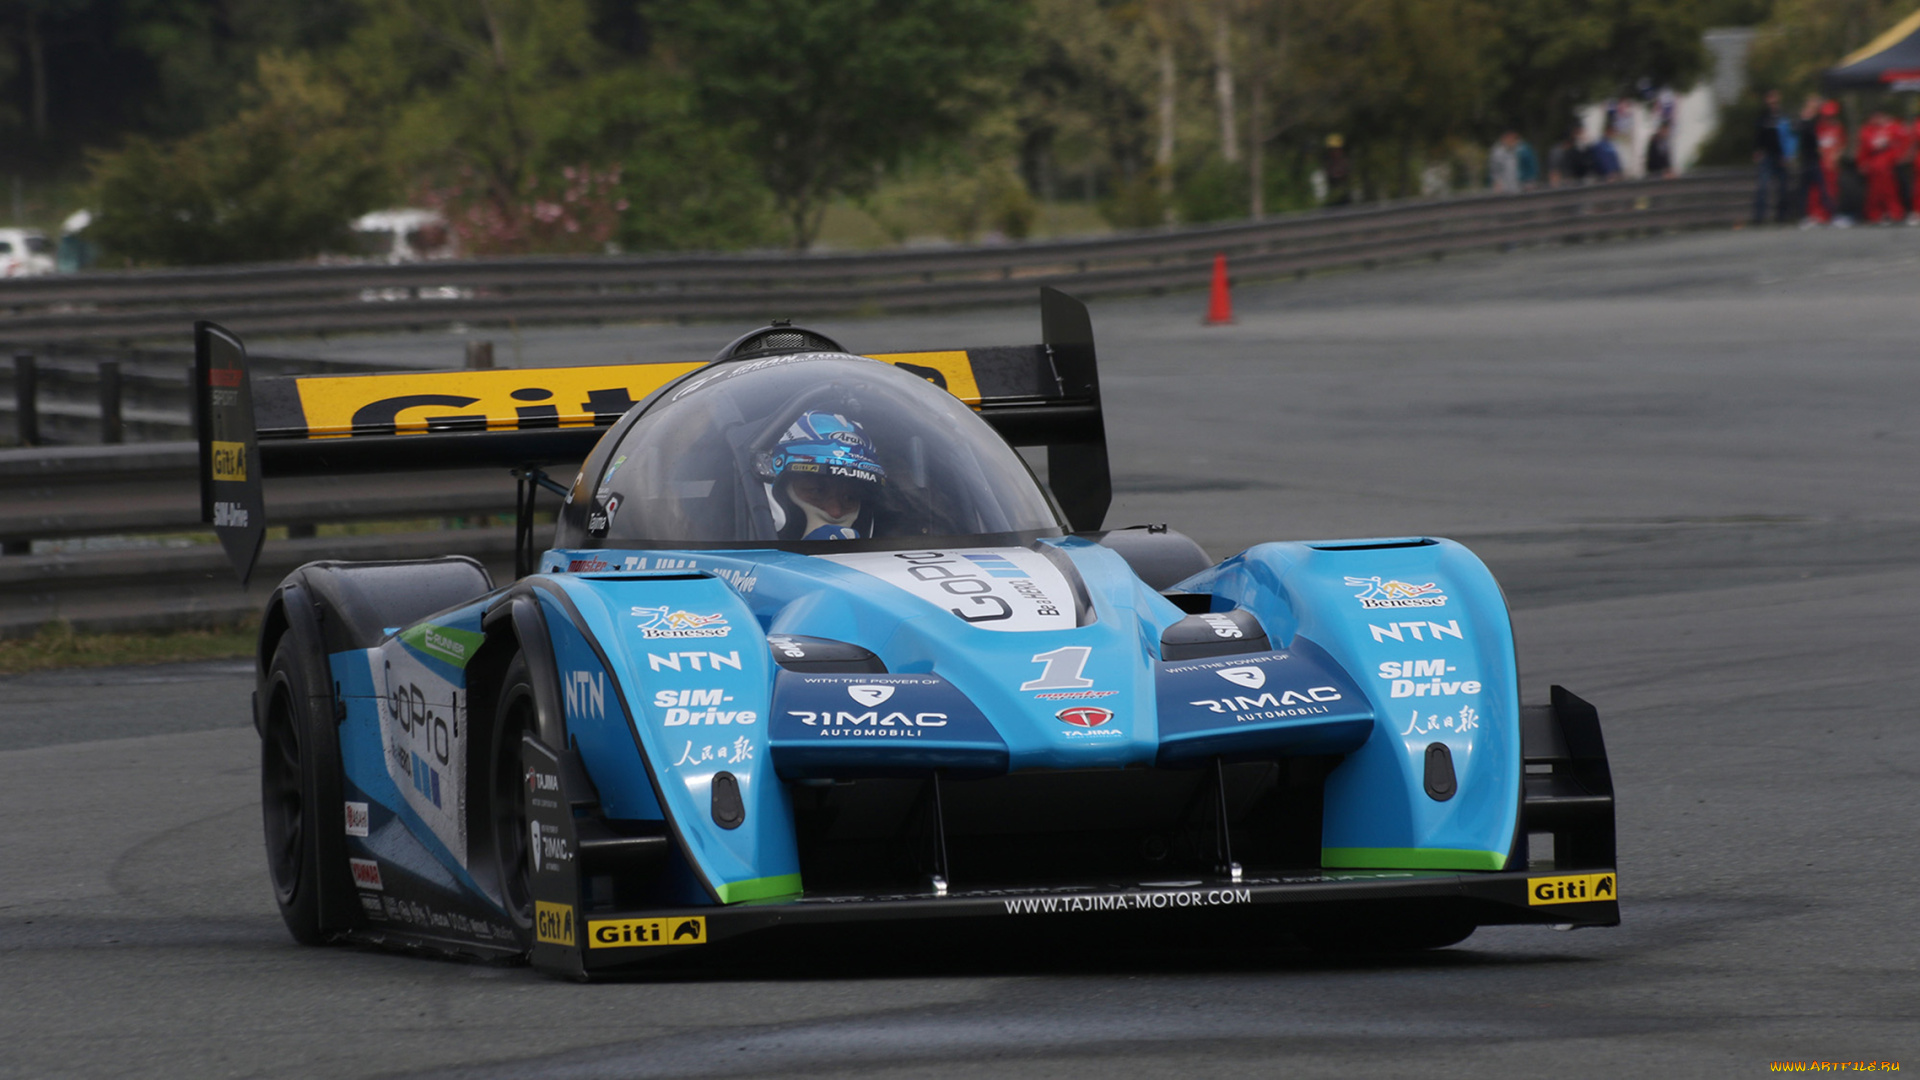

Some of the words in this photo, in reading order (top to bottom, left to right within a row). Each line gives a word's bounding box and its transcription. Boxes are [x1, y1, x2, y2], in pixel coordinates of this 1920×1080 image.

[351, 387, 642, 436] Git
[829, 466, 877, 482] TAJIMA
[893, 552, 1014, 622] GoPro
[1361, 597, 1442, 608] Benesse
[645, 628, 725, 638] Benesse
[1368, 620, 1464, 643] NTN
[648, 651, 742, 672] NTN
[1020, 646, 1094, 691] 1
[1165, 666, 1198, 674] WITH
[1199, 662, 1223, 671] THE
[1224, 656, 1271, 667] POWER
[1378, 659, 1456, 679] SIM-
[565, 670, 605, 720] NTN
[653, 688, 734, 708] SIM-
[1390, 678, 1482, 698] Drive
[385, 660, 449, 767] GoPro
[664, 707, 757, 726] Drive
[1236, 705, 1329, 722] AUTOMOBILI
[820, 729, 922, 737] AUTOMOBILI
[536, 773, 558, 791] TAJIMA
[1535, 880, 1585, 900] Giti
[1005, 889, 1251, 914] WWW.TAJIMA-MOTOR.COM
[538, 910, 561, 938] Giti
[596, 923, 660, 943] Giti
